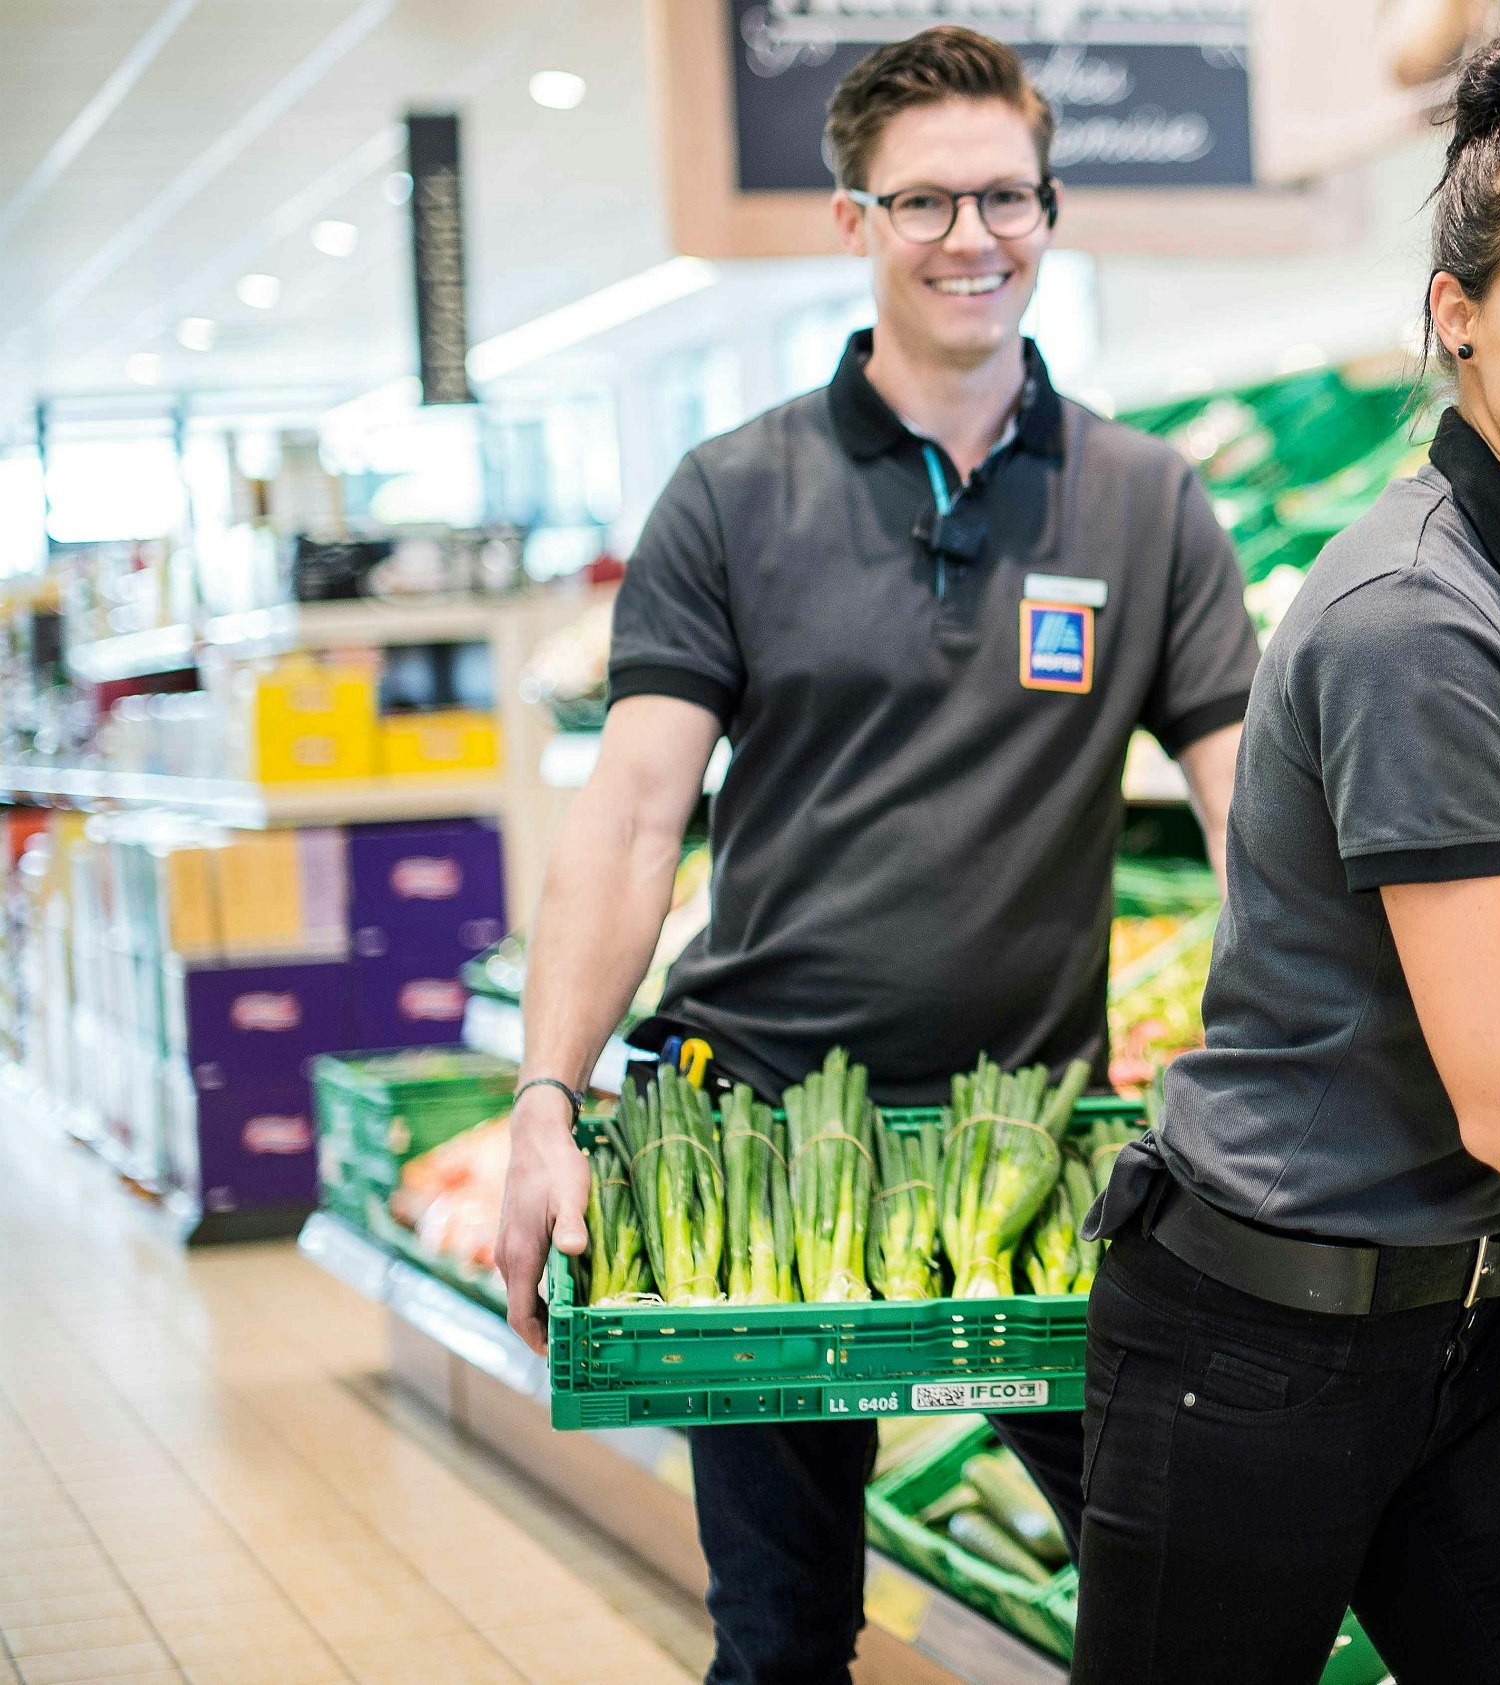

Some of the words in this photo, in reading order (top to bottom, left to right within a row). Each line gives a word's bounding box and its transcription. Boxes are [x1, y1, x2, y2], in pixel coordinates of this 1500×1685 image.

[970, 1384, 1016, 1399] IFCO
[829, 1398, 849, 1413] LL
[858, 1397, 898, 1412] 6408
